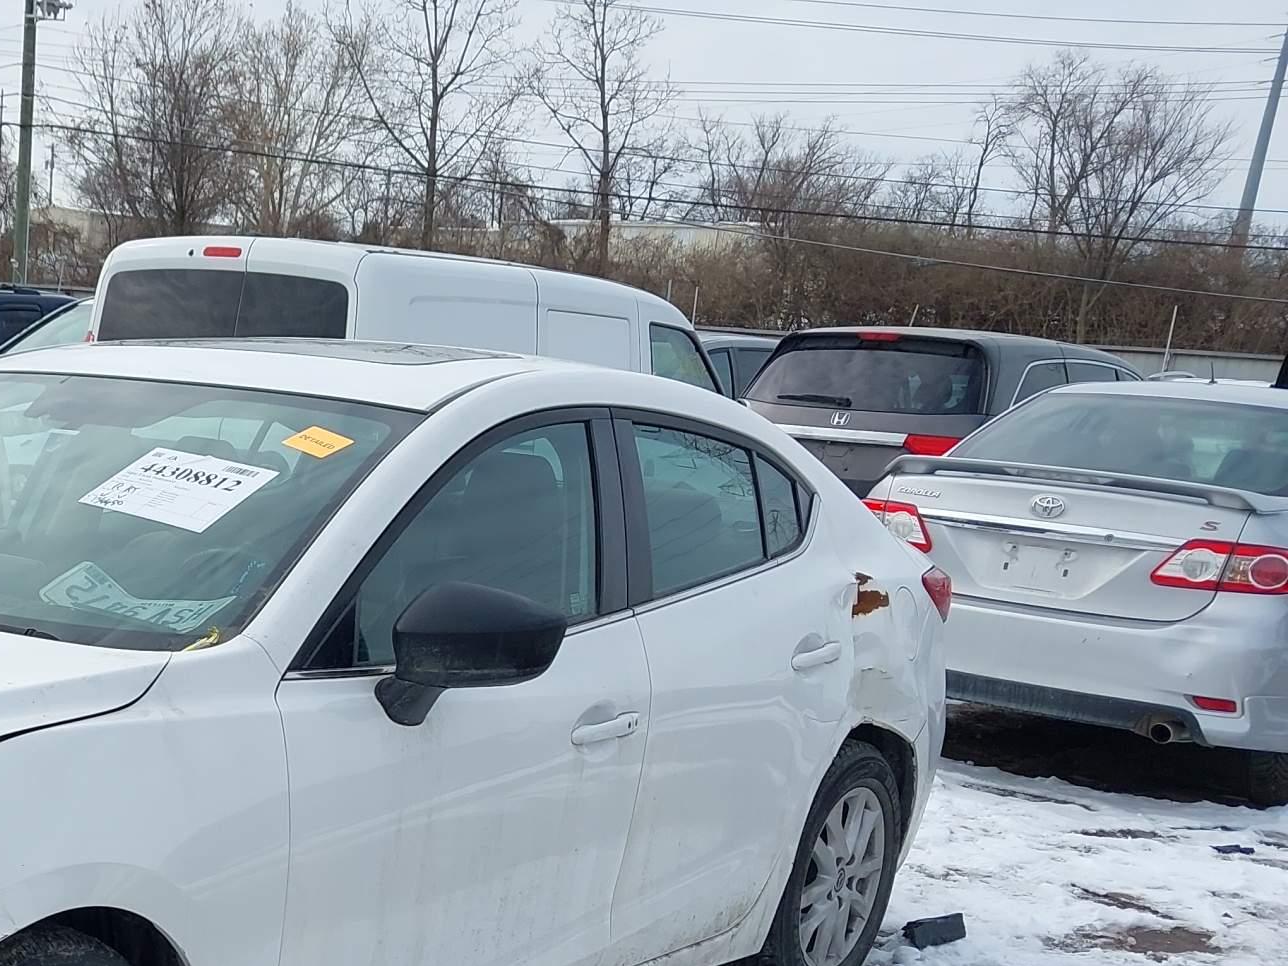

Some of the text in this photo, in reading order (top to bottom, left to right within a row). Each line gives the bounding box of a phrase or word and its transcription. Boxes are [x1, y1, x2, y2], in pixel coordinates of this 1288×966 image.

[140, 463, 242, 491] 44308812
[897, 486, 942, 498] COROLLA
[1200, 521, 1221, 531] S
